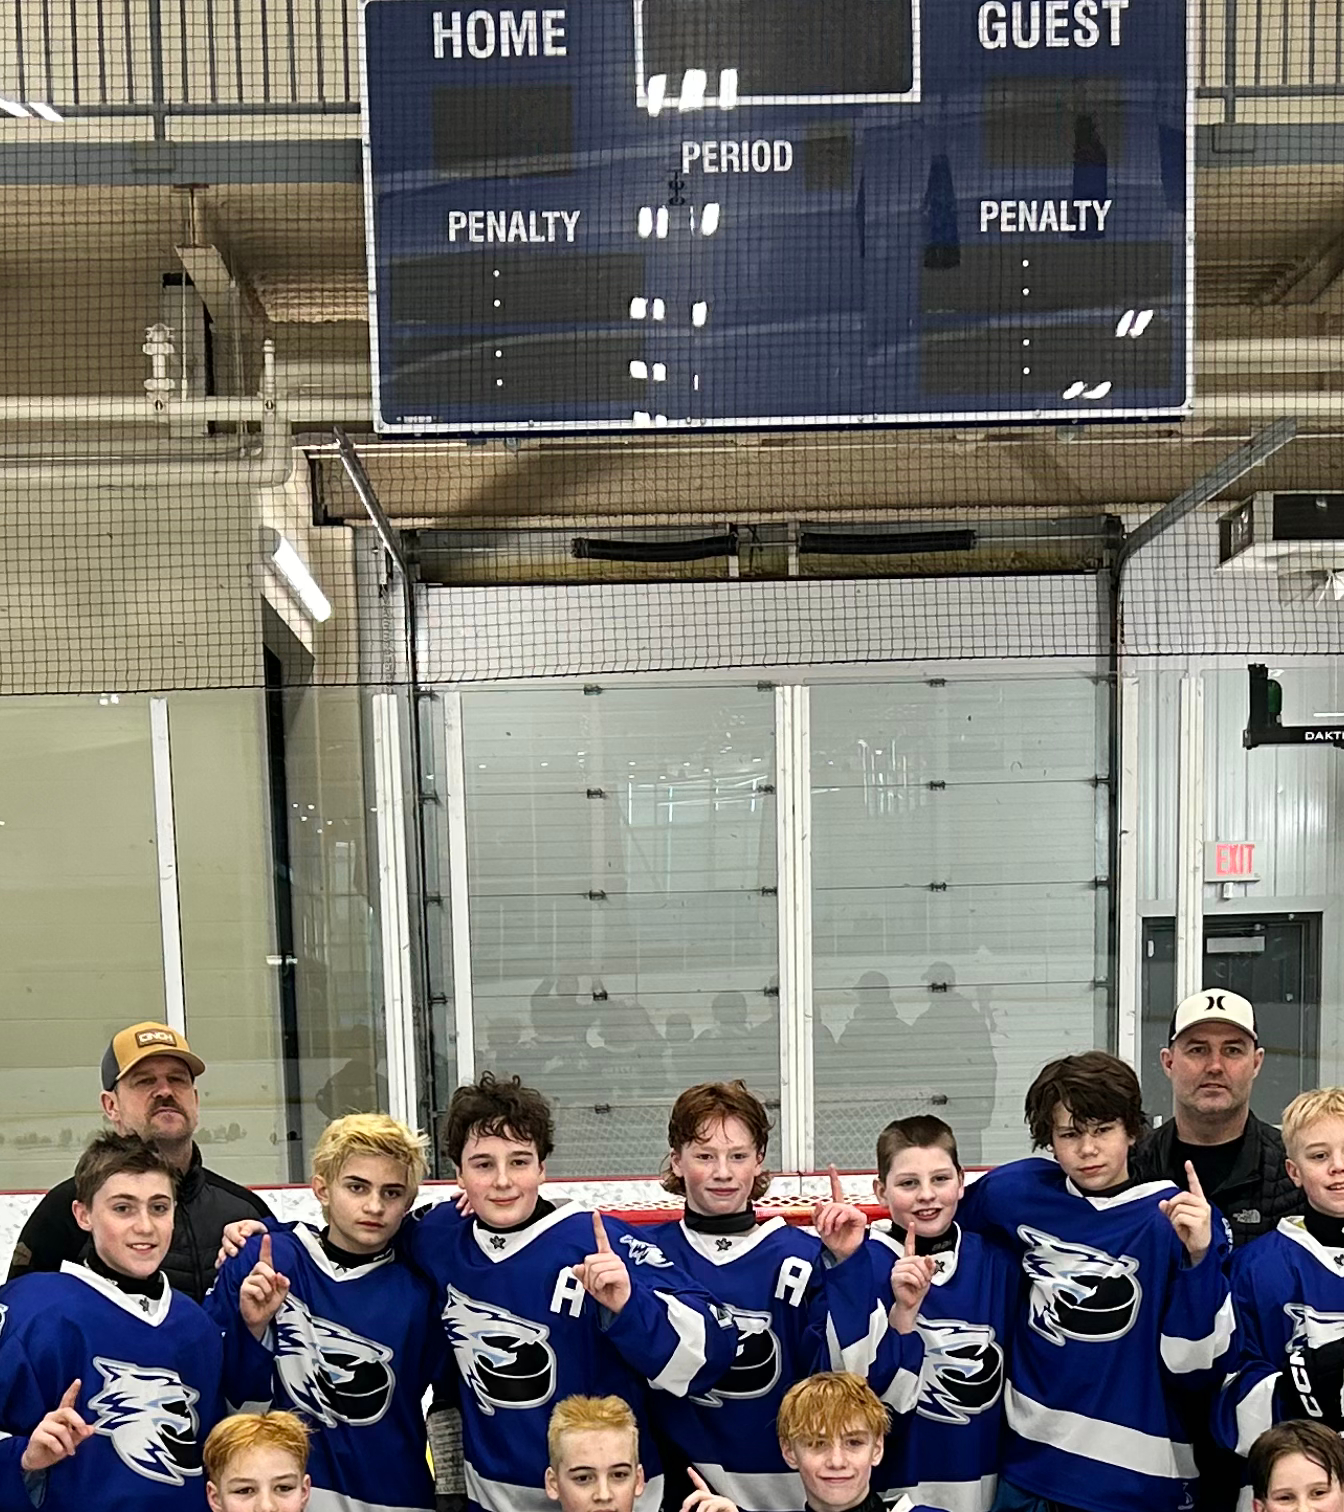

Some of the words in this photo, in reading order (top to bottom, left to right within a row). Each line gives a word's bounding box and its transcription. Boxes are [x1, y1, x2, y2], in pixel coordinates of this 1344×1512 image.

[431, 9, 568, 59] HOME
[978, 1, 1130, 49] GUEST
[681, 140, 794, 174] PERIOD
[448, 209, 581, 244] PENALTY
[980, 199, 1113, 233] PENALTY
[1216, 843, 1256, 876] EXIT
[549, 1265, 587, 1319] A
[775, 1255, 813, 1308] A
